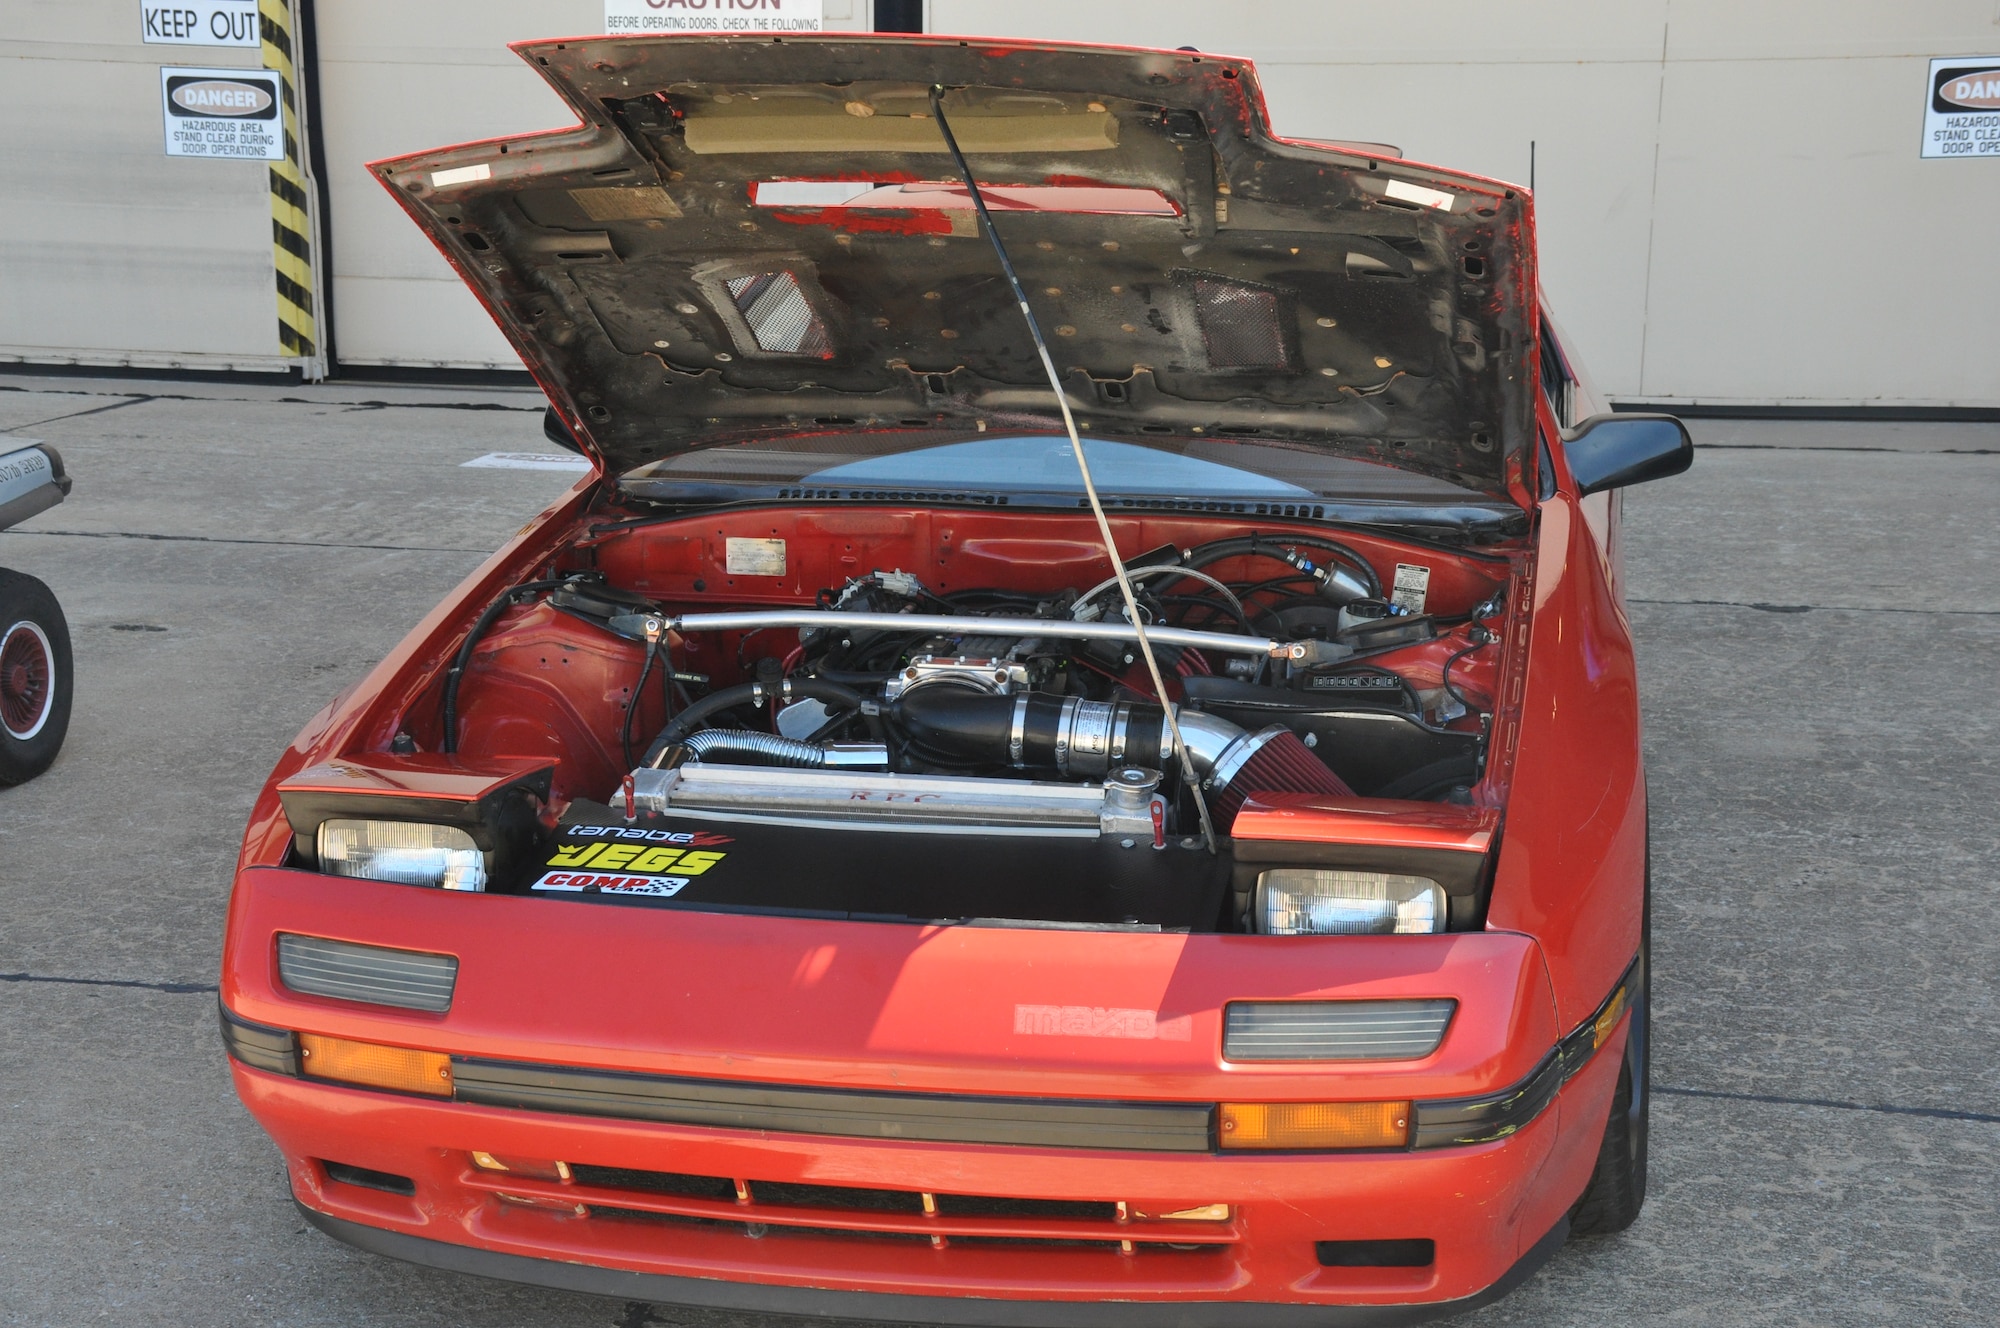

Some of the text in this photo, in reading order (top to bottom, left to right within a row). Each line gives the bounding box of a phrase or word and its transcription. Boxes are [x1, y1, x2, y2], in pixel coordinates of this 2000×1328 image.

[145, 8, 256, 41] KEEP OUT
[608, 16, 640, 28] BEFORE
[642, 16, 686, 29] OPERATING
[723, 17, 750, 30] CHECK
[754, 18, 768, 30] THE
[772, 18, 818, 31] FOLLOWING
[184, 89, 257, 107] DANGER
[182, 120, 264, 133] HAZARDOUS AREA
[1946, 116, 2000, 128] HAZARDO
[173, 131, 274, 145] STAND CLEAR DURING
[1934, 129, 2000, 142] STAND CLE
[182, 143, 267, 156] DOOR OPERATIONS
[1942, 142, 1974, 154] DOOR
[567, 824, 695, 843] tanabe
[546, 842, 727, 876] JEGS
[543, 873, 650, 889] COMP
